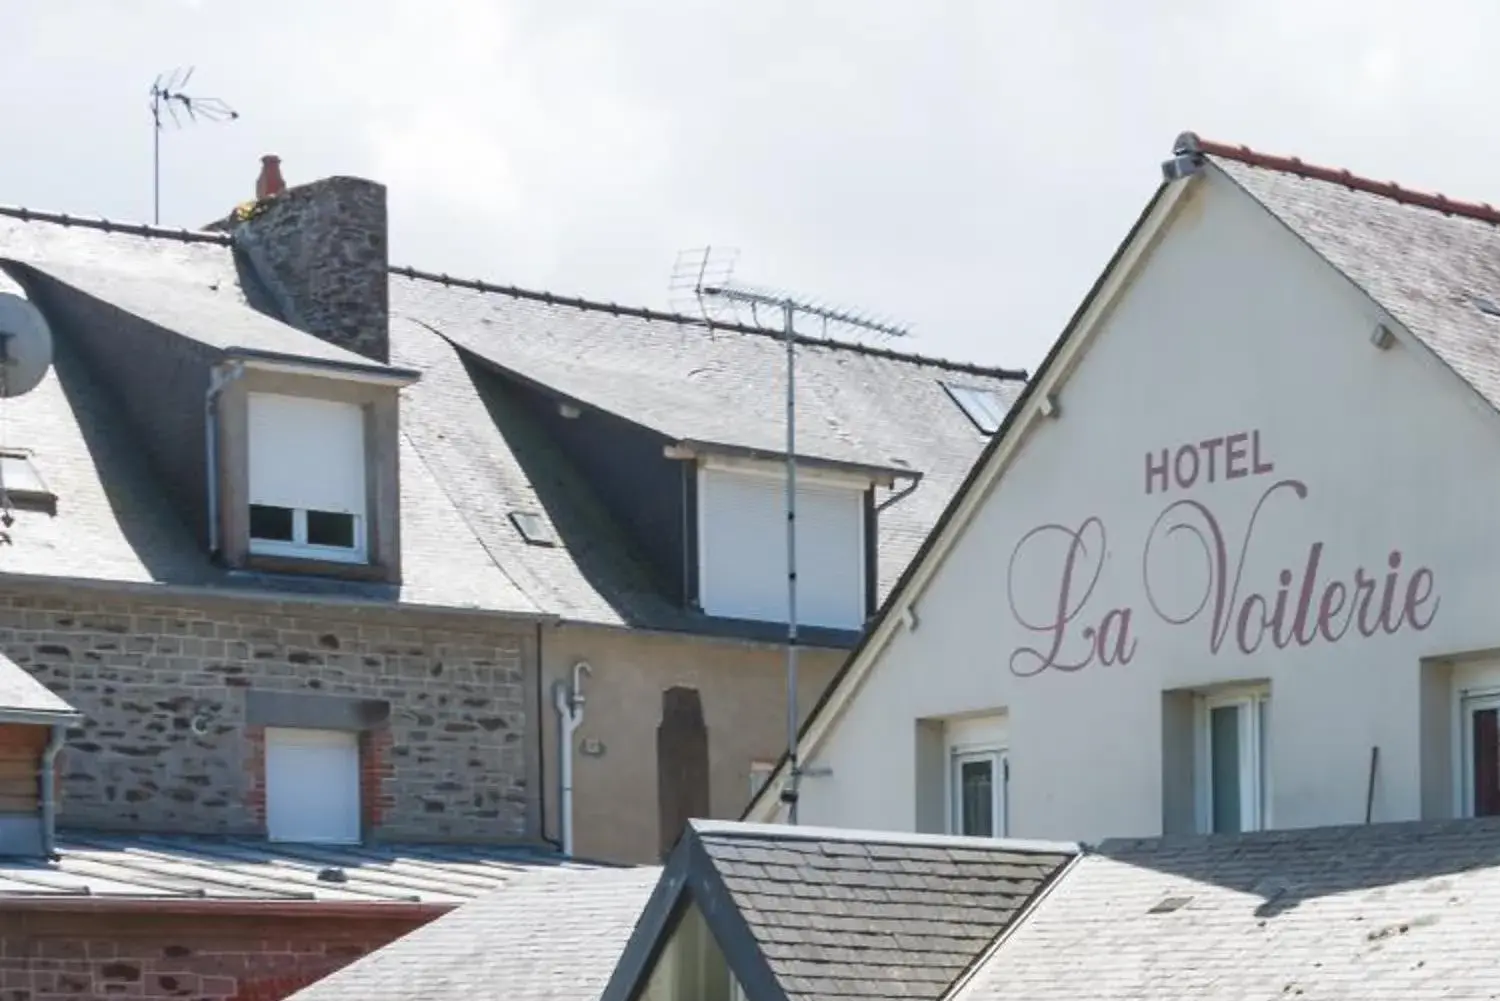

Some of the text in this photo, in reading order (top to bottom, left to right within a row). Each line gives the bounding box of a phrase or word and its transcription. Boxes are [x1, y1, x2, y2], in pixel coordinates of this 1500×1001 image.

[1145, 430, 1273, 494] HOTEL
[1008, 480, 1440, 677] La Voilerie
